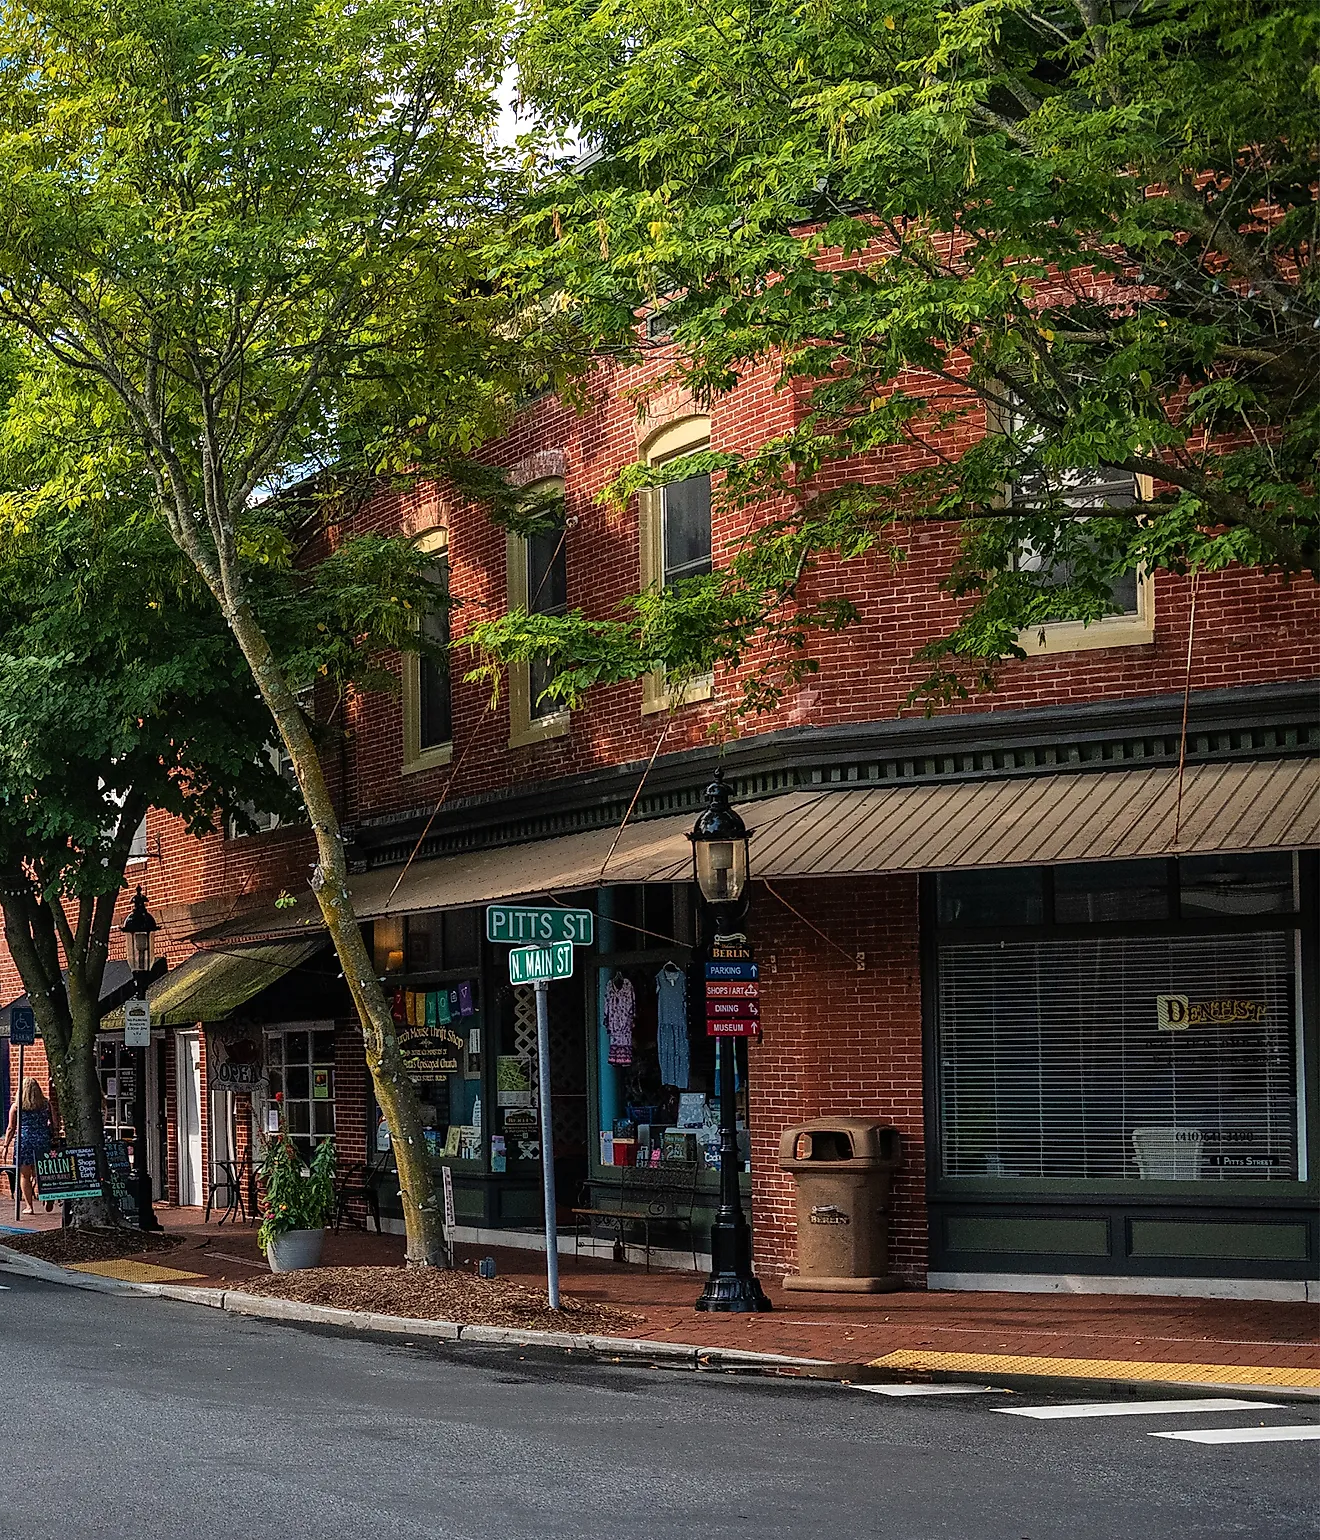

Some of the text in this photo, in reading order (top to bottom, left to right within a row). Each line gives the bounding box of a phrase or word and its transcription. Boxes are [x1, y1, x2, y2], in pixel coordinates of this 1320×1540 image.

[492, 911, 588, 940] PITTS ST
[712, 948, 750, 958] BERLIN
[511, 946, 570, 980] N. MAIN ST
[710, 966, 741, 975] PARKING
[706, 986, 728, 995] SHOPS
[732, 987, 745, 995] ART
[714, 1004, 739, 1013] DINING
[1165, 999, 1267, 1023] DENTIST
[713, 1023, 744, 1032] MUSEUM
[447, 1029, 464, 1050] Shop
[440, 1057, 458, 1069] Church
[220, 1062, 262, 1083] OPEN
[37, 1157, 70, 1175] BERLIN
[1216, 1157, 1274, 1166] 1 PITTS STREET
[79, 1165, 96, 1173] Open
[80, 1171, 95, 1179] Early
